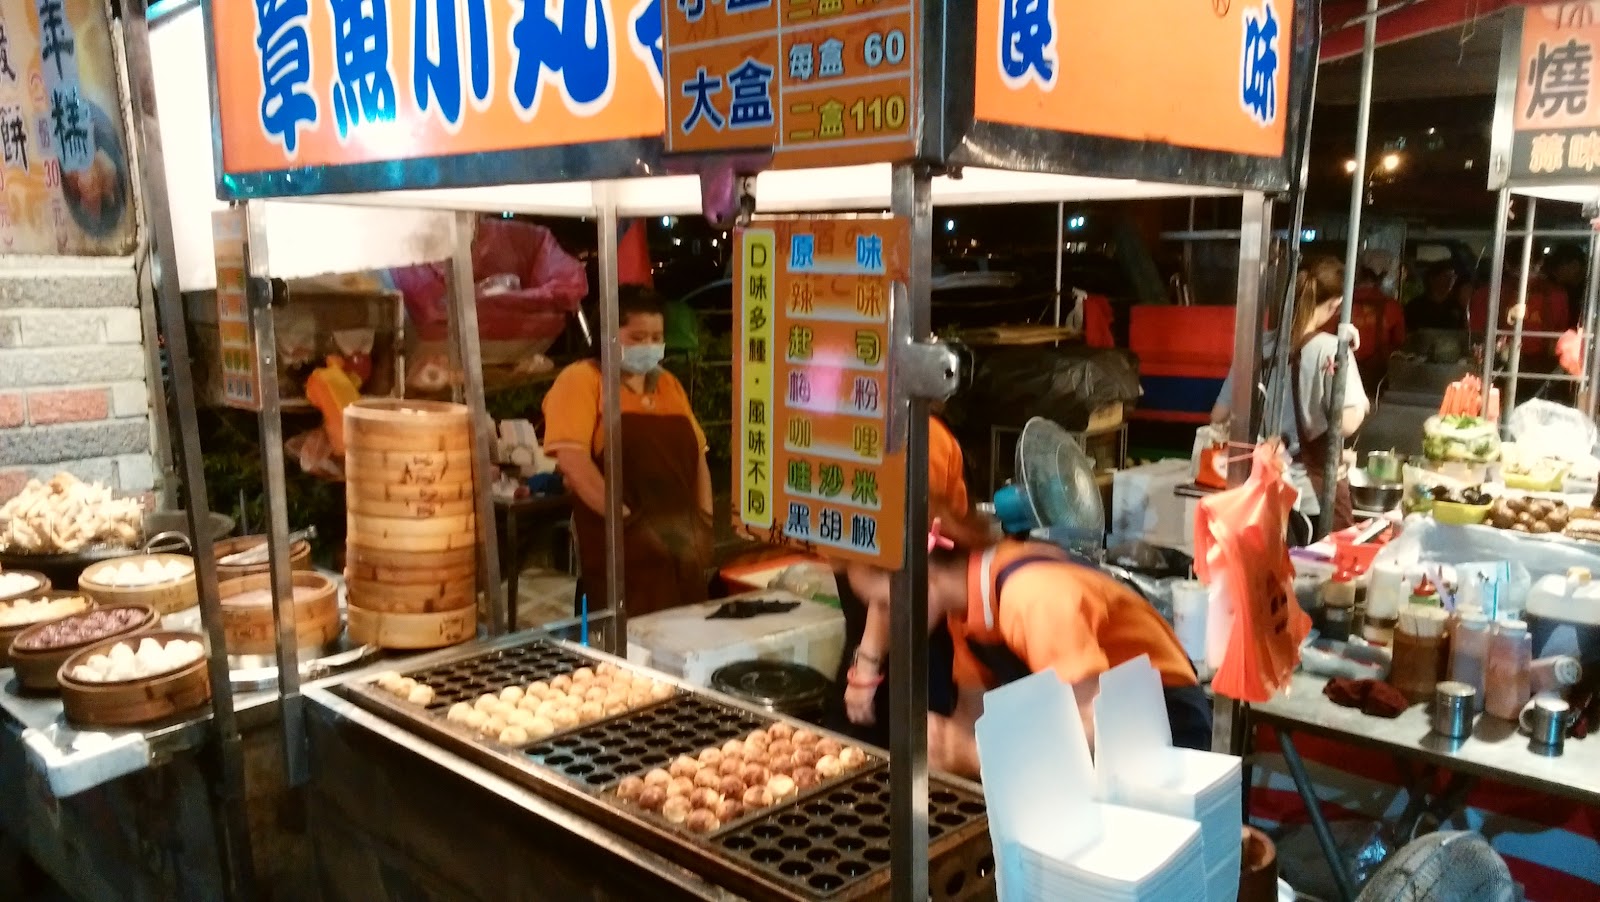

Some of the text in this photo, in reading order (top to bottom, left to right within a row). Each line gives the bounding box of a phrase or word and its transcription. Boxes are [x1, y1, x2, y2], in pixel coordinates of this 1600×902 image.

[256, 0, 664, 153] 章魚小丸
[789, 29, 906, 80] 每盒 60
[1243, 4, 1279, 121] 味
[681, 56, 775, 134] 大盒
[1526, 38, 1593, 120] 燒
[790, 234, 883, 270] 原味
[790, 278, 884, 317] 辣味
[788, 325, 882, 366] 起司
[788, 370, 881, 412] 梅粉
[788, 416, 879, 458] 咖哩
[787, 459, 878, 507] 哇沙米
[788, 501, 877, 550] 黑胡椒
